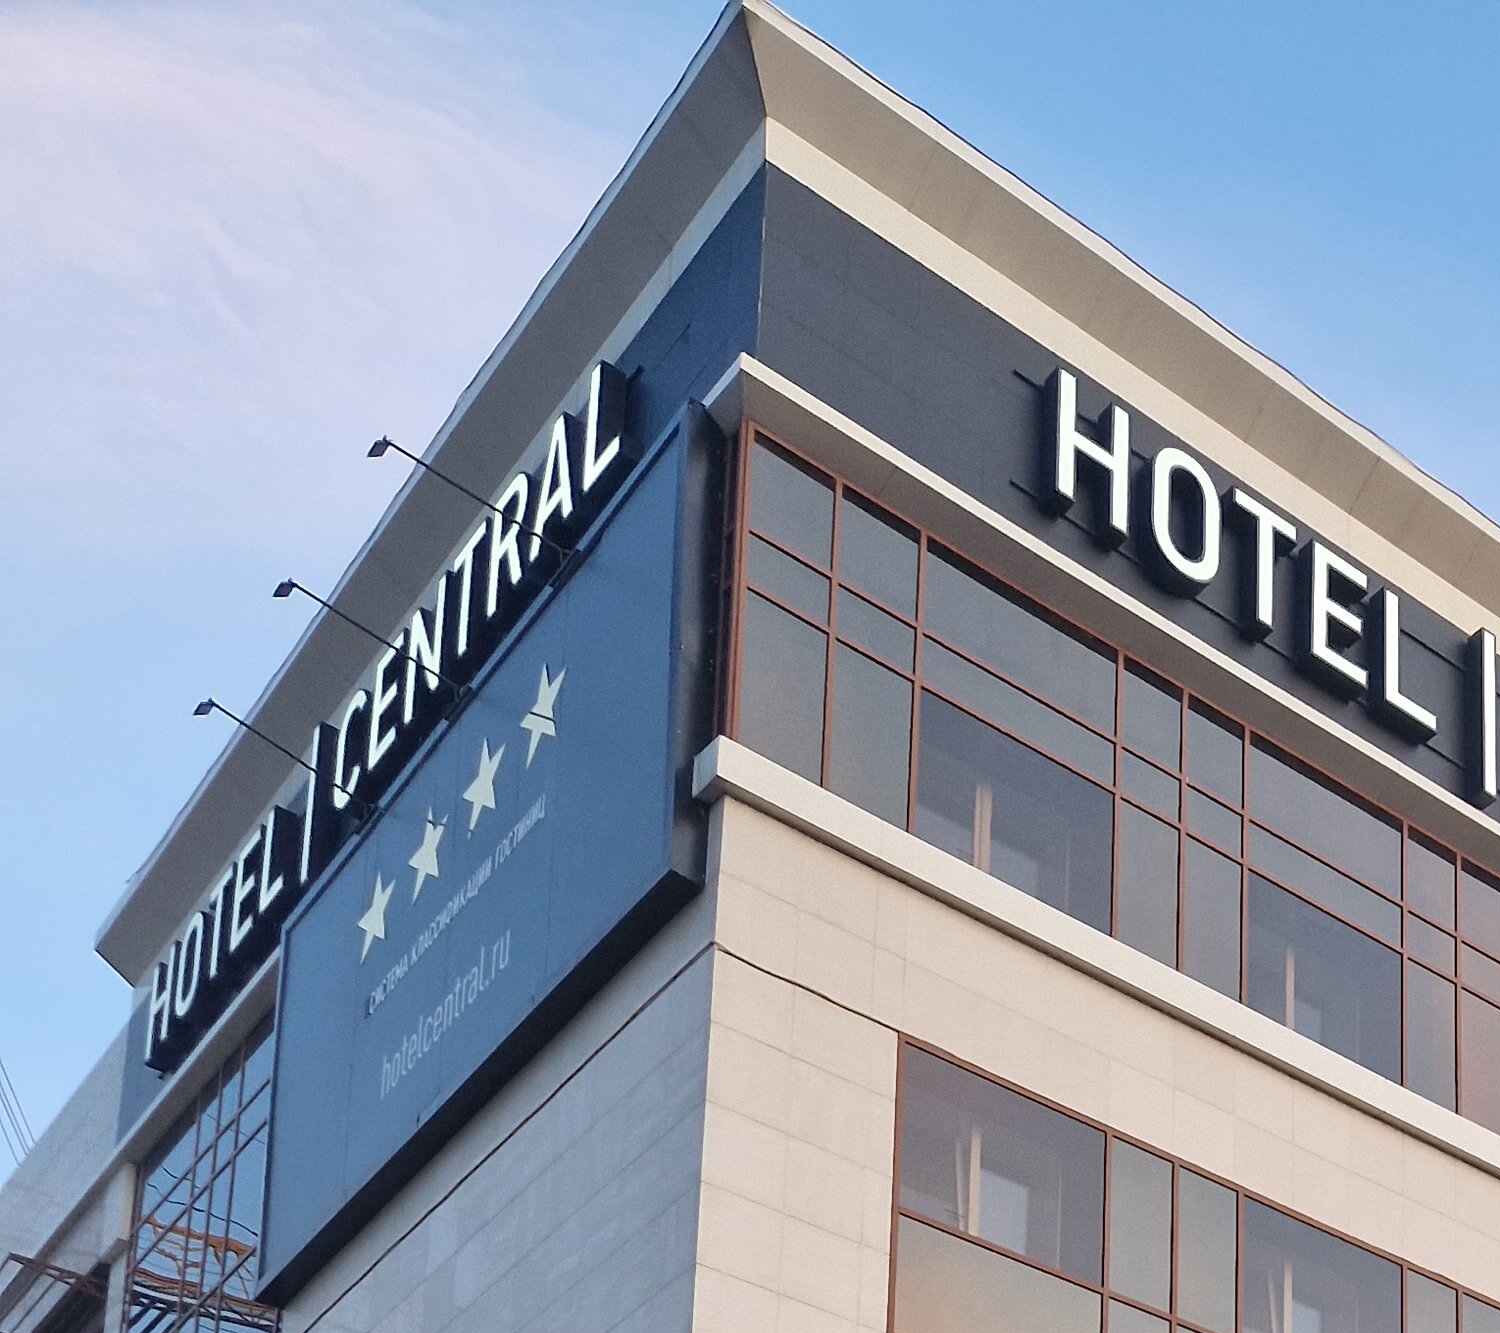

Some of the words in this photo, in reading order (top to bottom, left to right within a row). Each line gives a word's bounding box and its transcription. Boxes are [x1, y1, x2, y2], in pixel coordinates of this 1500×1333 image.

[1056, 368, 1438, 736] HOTEL
[145, 808, 284, 1060] HOTEL
[331, 362, 622, 811] CENTRAL
[368, 960, 409, 1015] СИСТЕМА
[410, 856, 493, 966] КЛАССИФИКАЦИИ
[494, 793, 547, 869] ГОСТИНИЦ
[380, 929, 511, 1100] hotelcentral.ru
